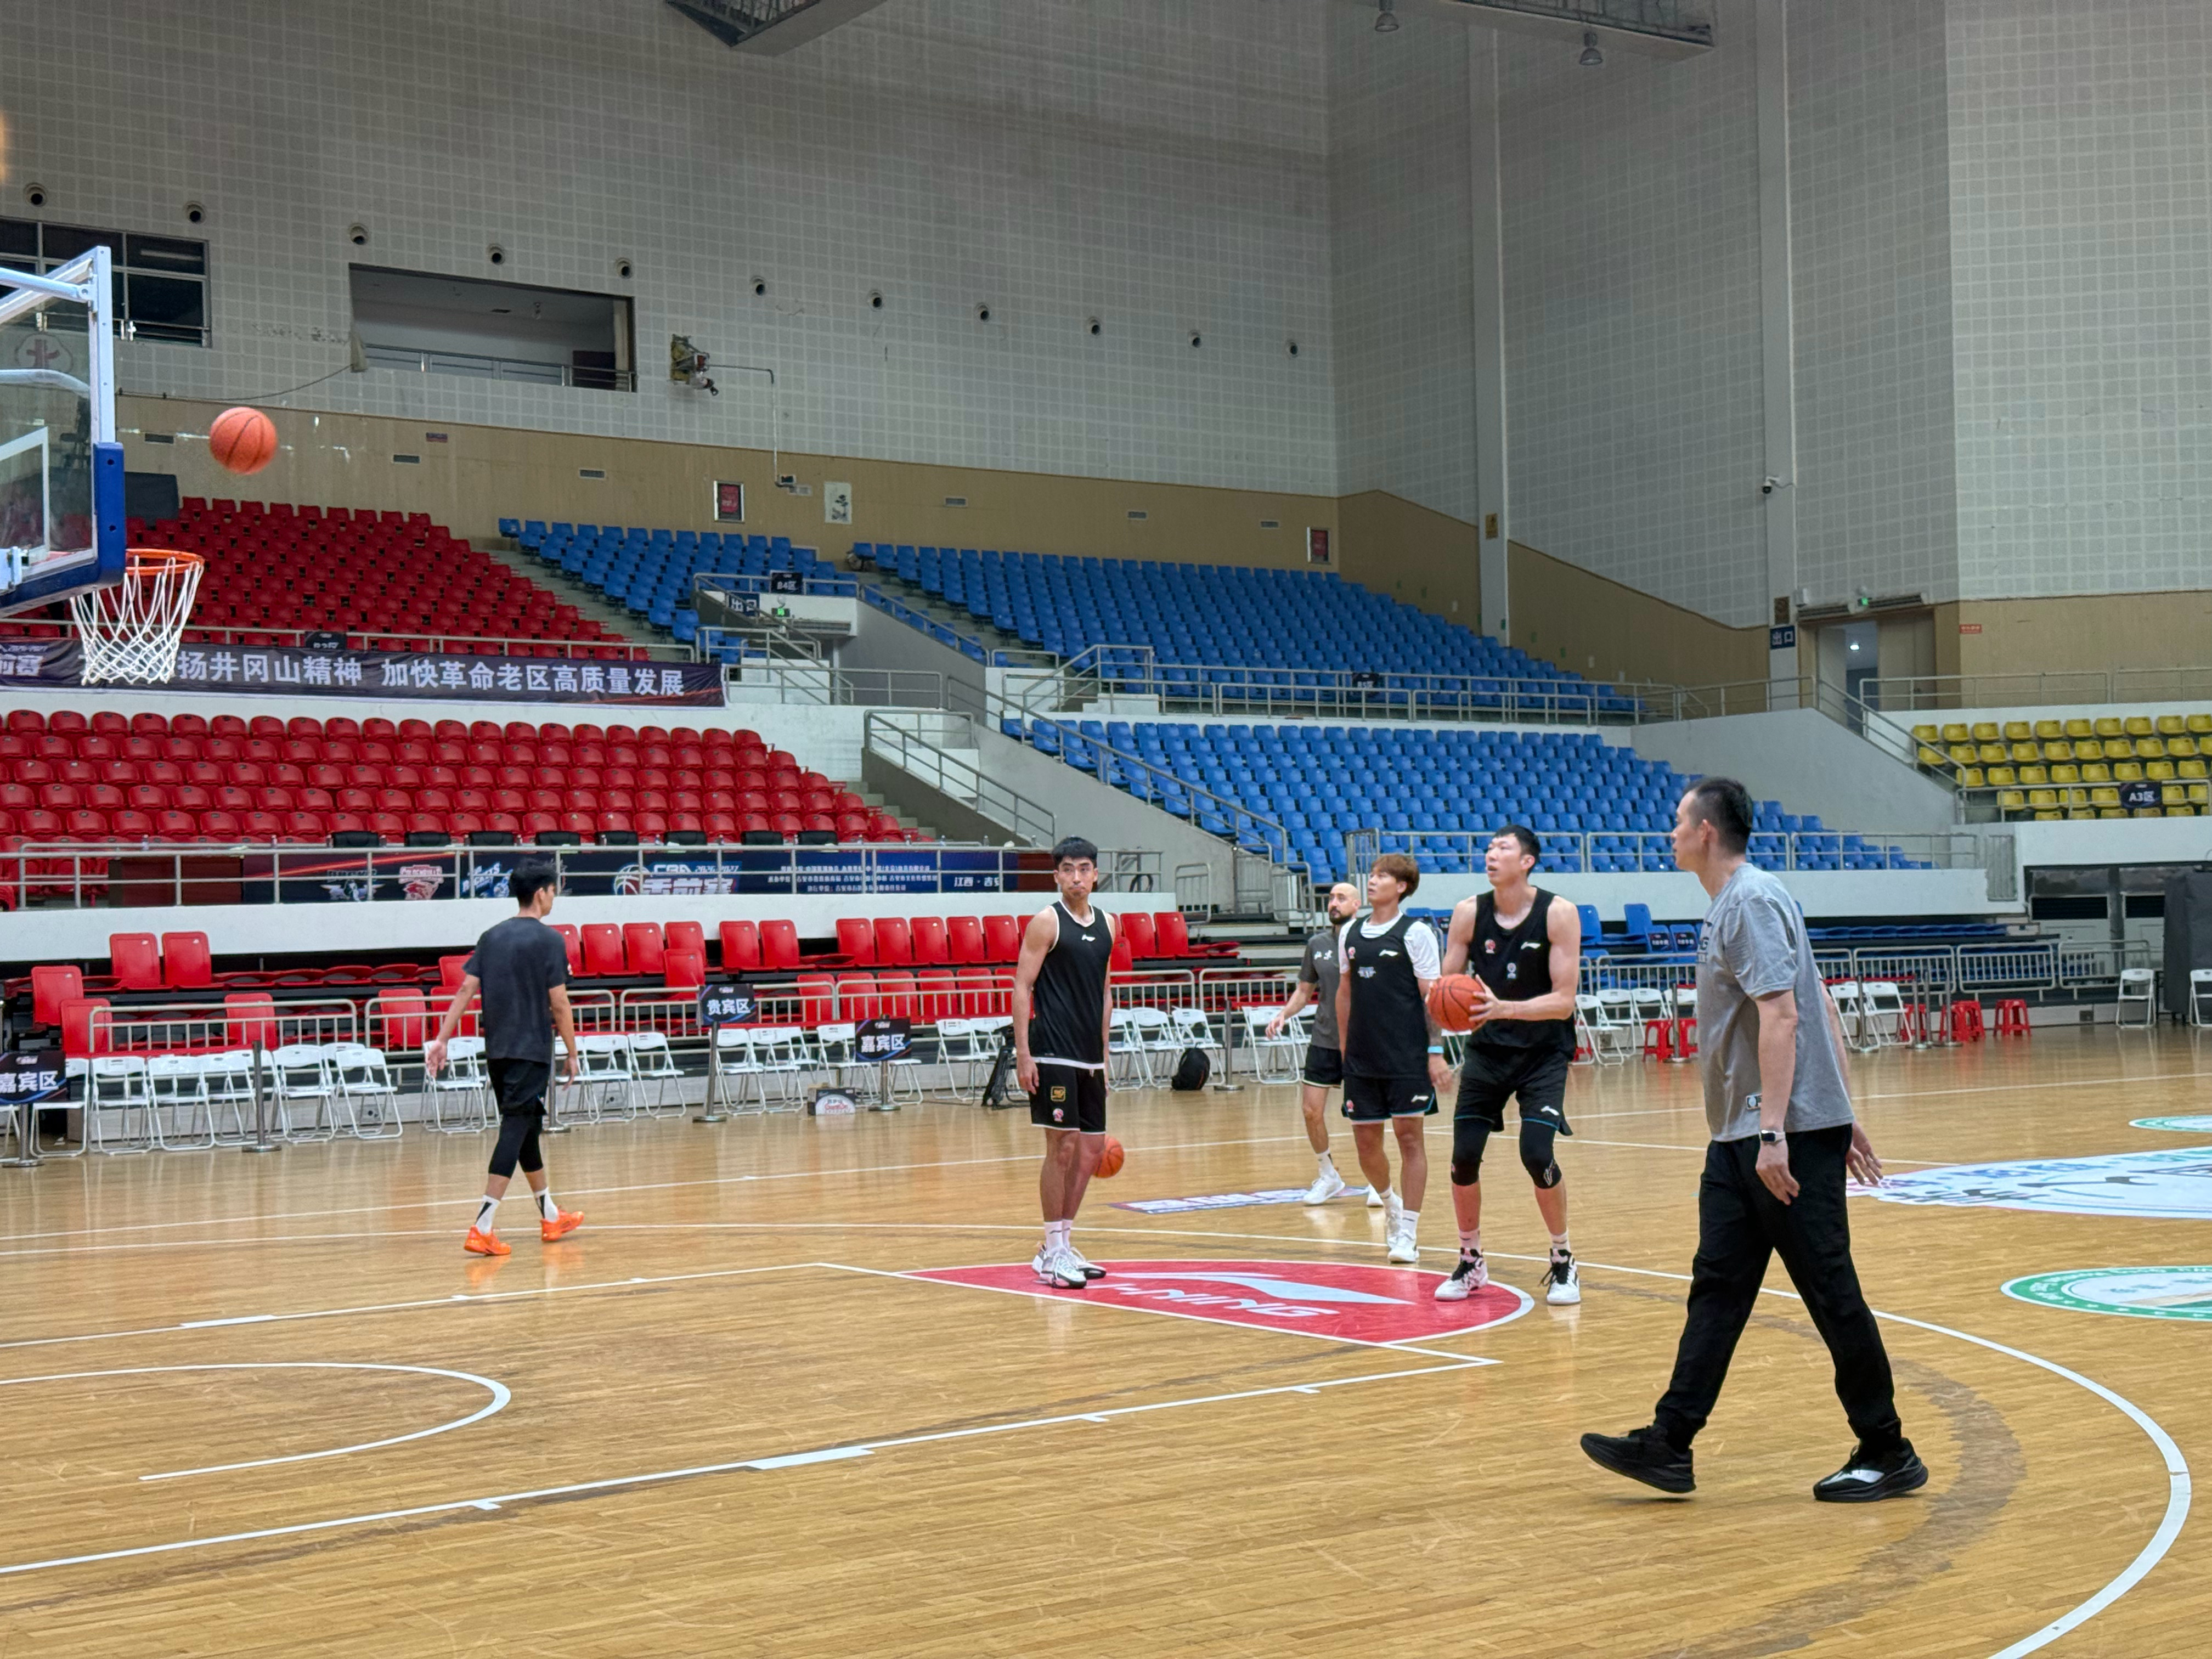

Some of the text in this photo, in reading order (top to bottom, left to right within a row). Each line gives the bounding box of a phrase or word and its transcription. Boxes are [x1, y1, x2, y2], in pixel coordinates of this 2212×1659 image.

[78, 651, 685, 696] 扬井冈山精神 加快革命老区高质量发展
[2129, 791, 2155, 802] A3区
[707, 998, 751, 1015] 贵宾区
[861, 1033, 906, 1053] 嘉宾区
